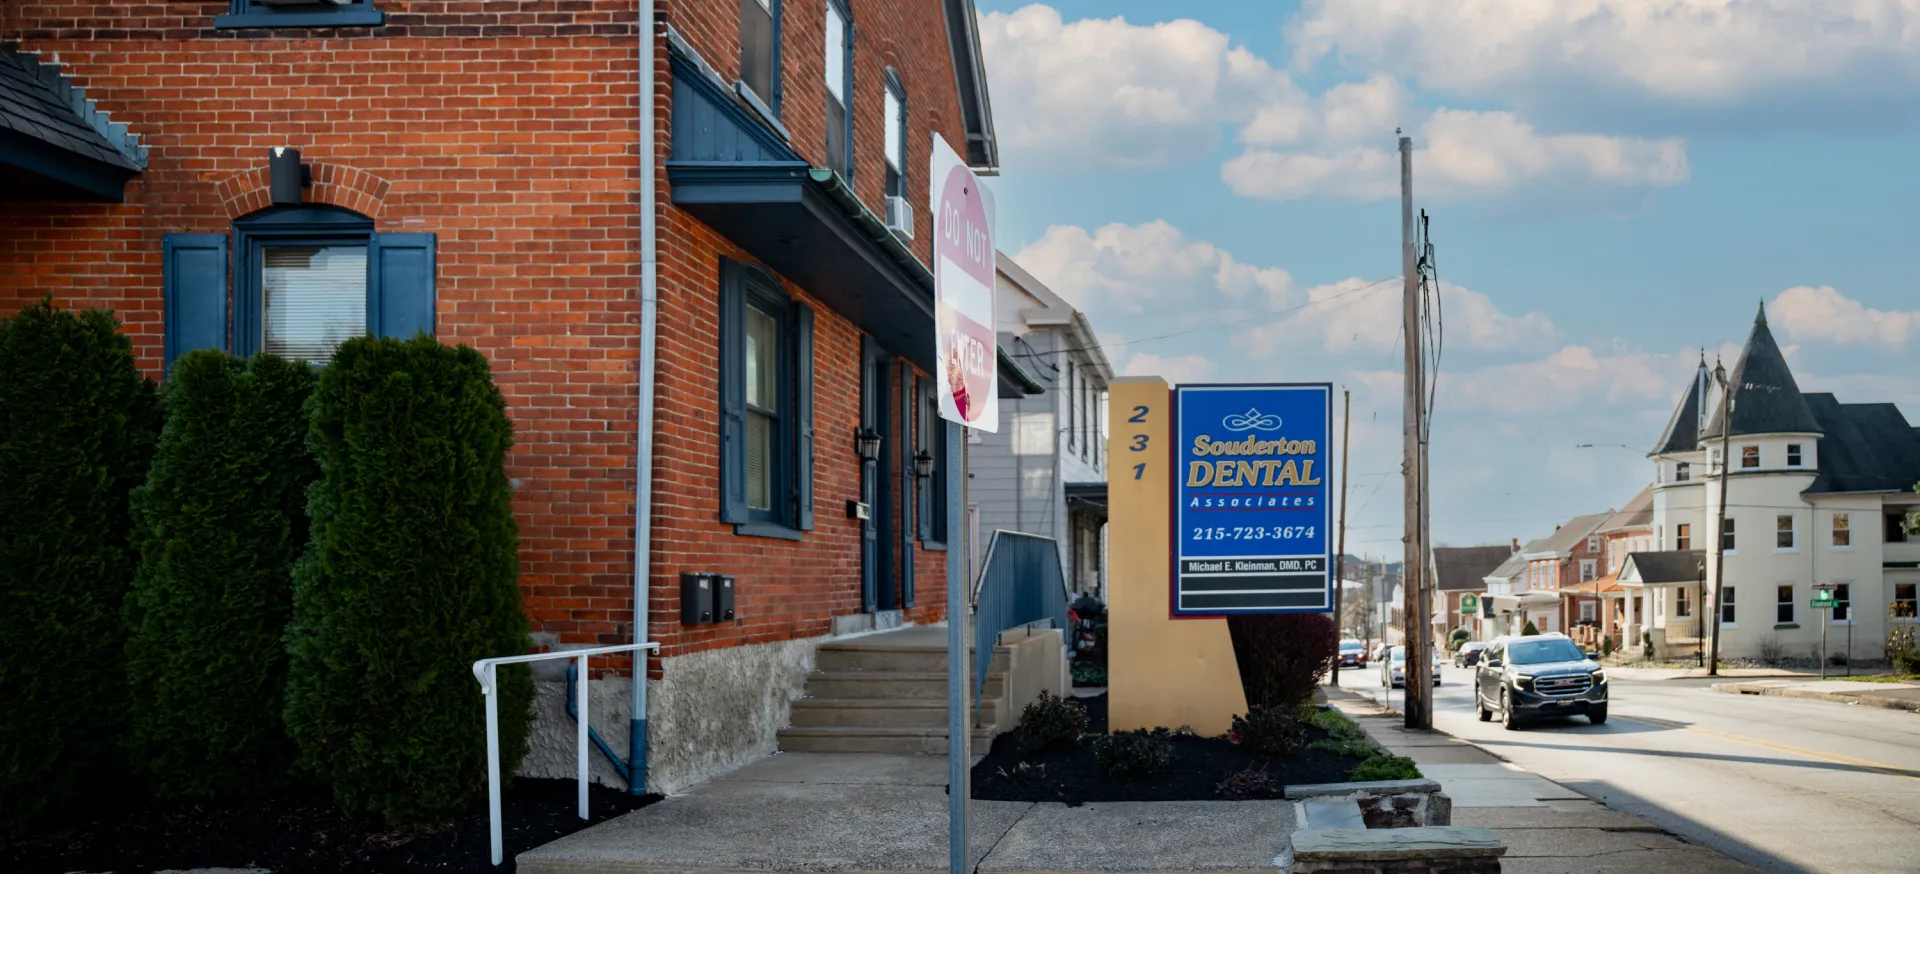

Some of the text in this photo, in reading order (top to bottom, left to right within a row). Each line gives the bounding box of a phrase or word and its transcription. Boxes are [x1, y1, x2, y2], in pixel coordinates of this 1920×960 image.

[945, 200, 987, 267] DO NOT
[950, 327, 985, 377] ENTER
[1192, 434, 1316, 456] Souderton
[1186, 459, 1320, 487] DENTAL
[1190, 496, 1314, 507] Associates
[1193, 526, 1315, 541] 215-723-3674
[1188, 559, 1317, 572] Michael E. Kleinman, DMD, PC
